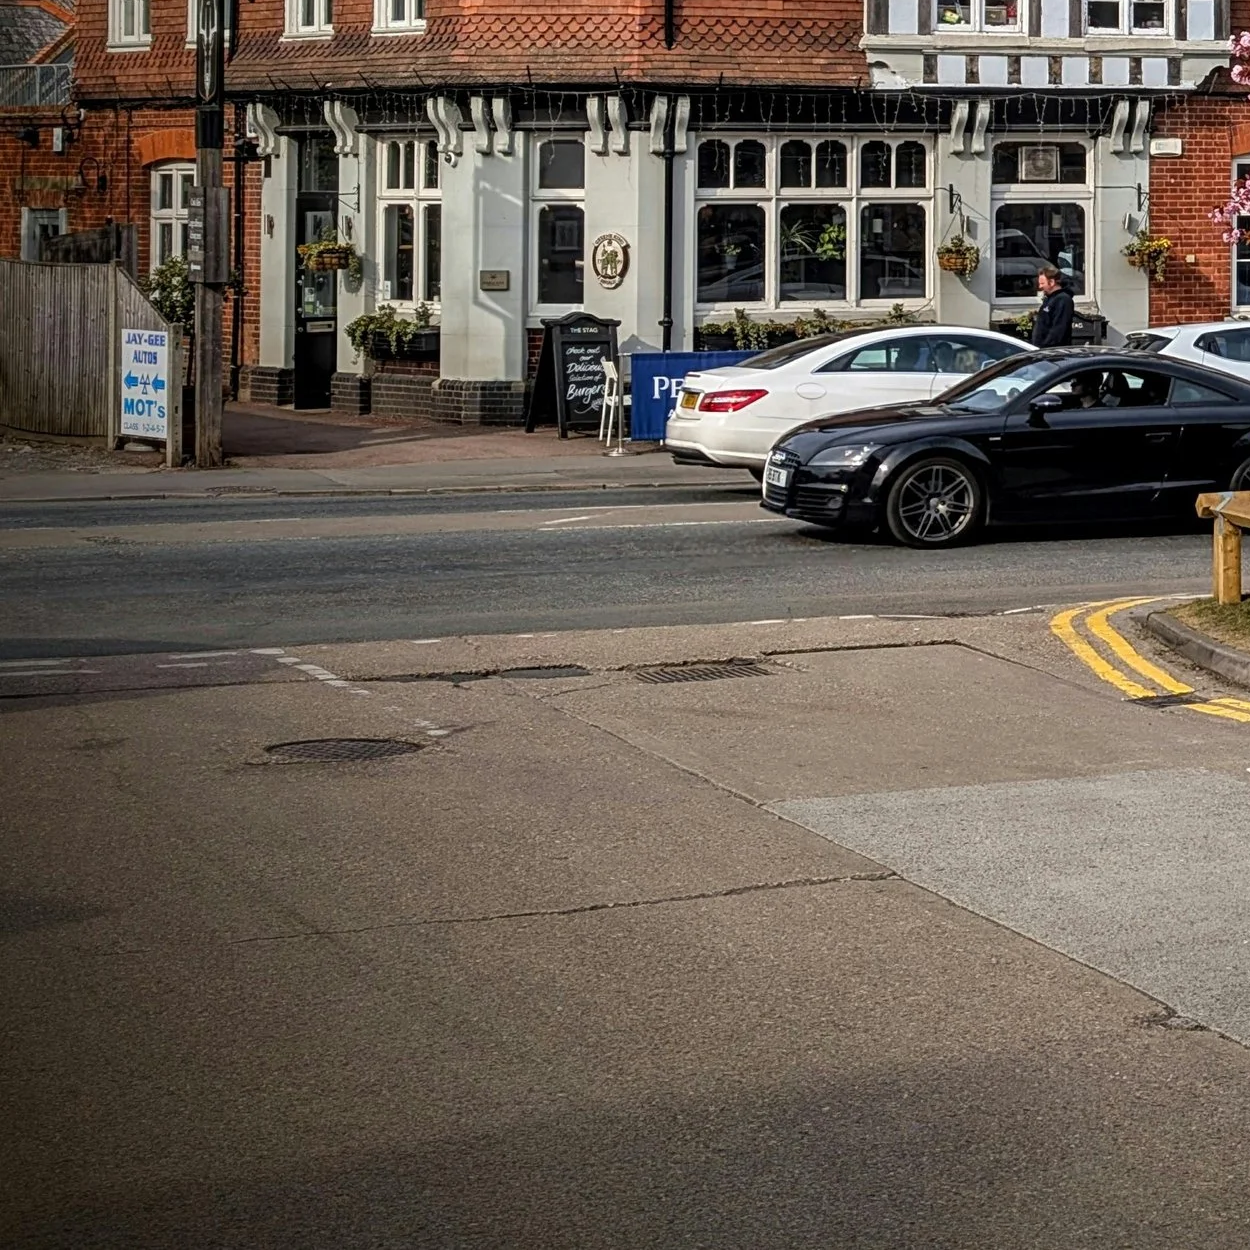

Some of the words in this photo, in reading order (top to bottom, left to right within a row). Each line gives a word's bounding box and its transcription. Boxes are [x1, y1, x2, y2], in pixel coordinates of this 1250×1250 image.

[125, 332, 166, 347] JAY-GEE
[132, 350, 158, 365] AUTOS
[124, 397, 166, 419] MOT's
[123, 421, 138, 431] CLASS
